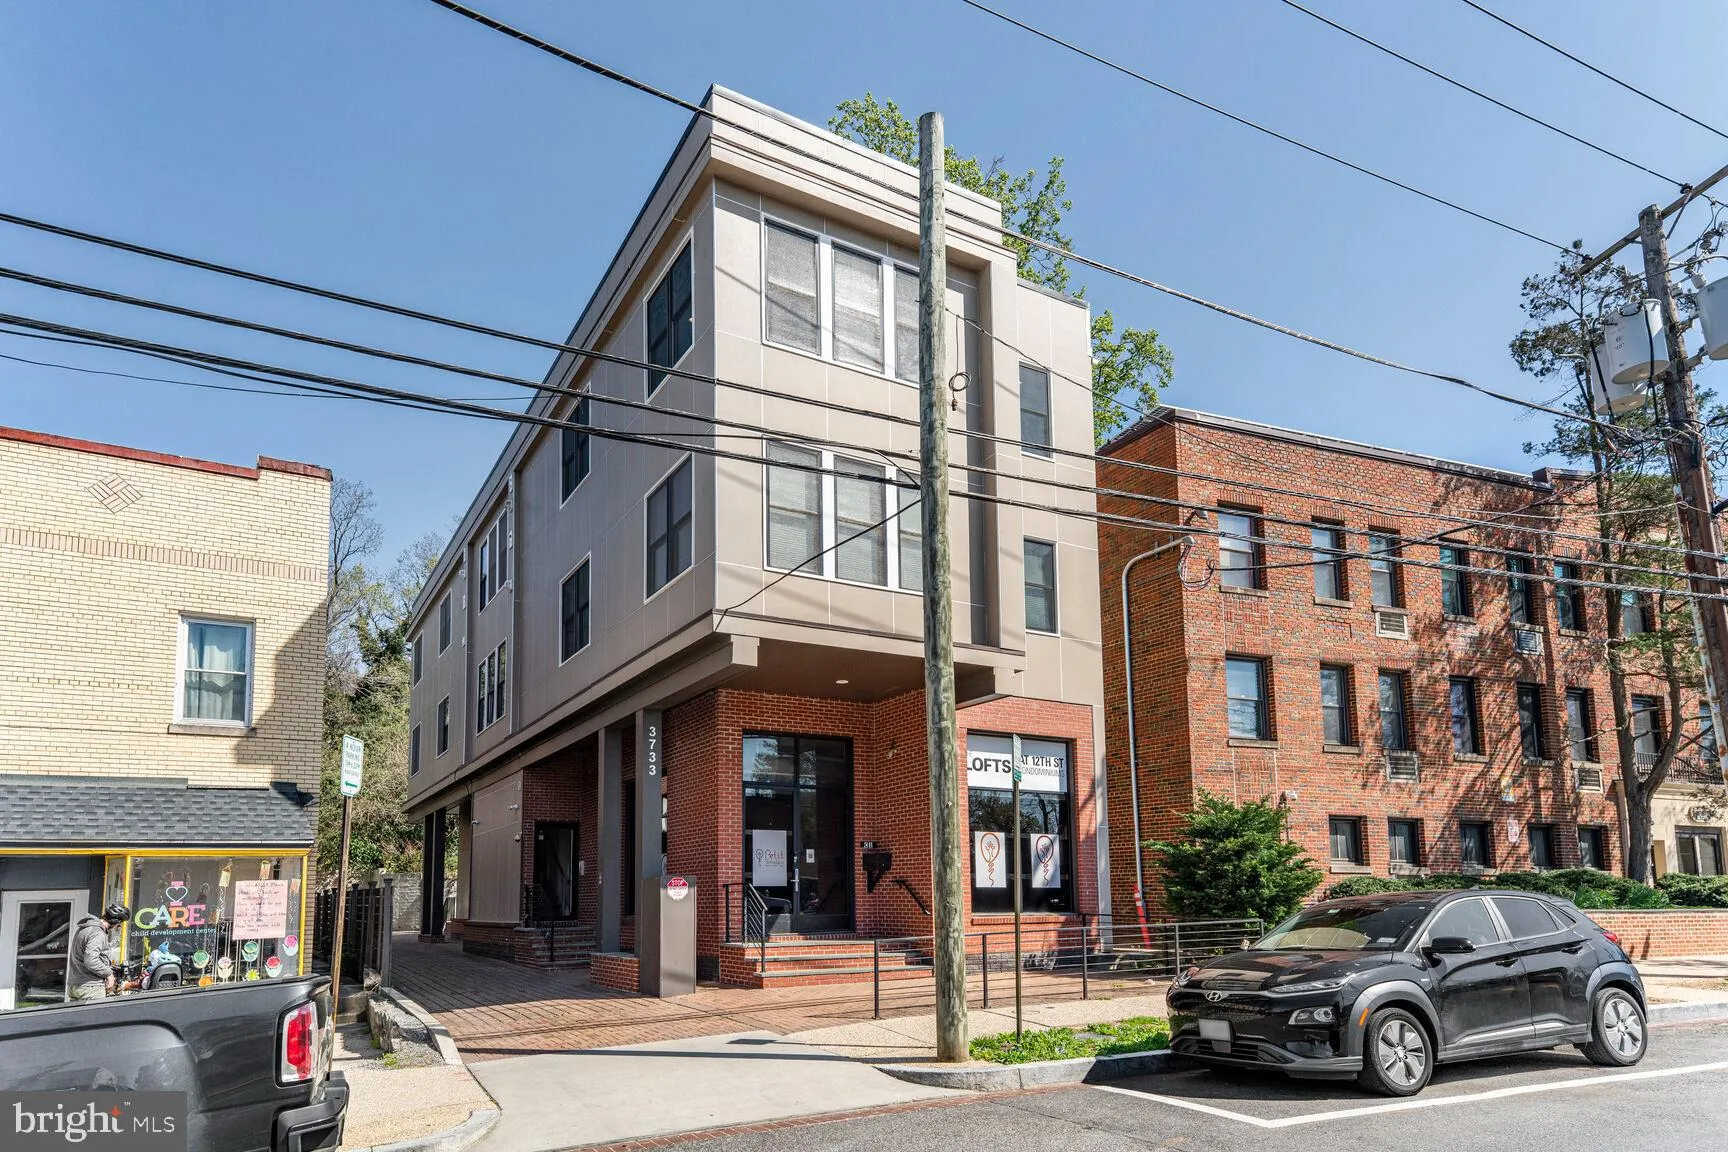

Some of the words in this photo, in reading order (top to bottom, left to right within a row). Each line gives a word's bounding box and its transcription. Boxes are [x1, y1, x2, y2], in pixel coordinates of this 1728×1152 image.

[967, 757, 1012, 773] OFTS
[1032, 756, 1051, 767] 12TH
[1054, 757, 1064, 768] ST
[1021, 767, 1065, 777] ONDOMINIUMS
[134, 904, 206, 930] CARE
[150, 928, 195, 936] development
